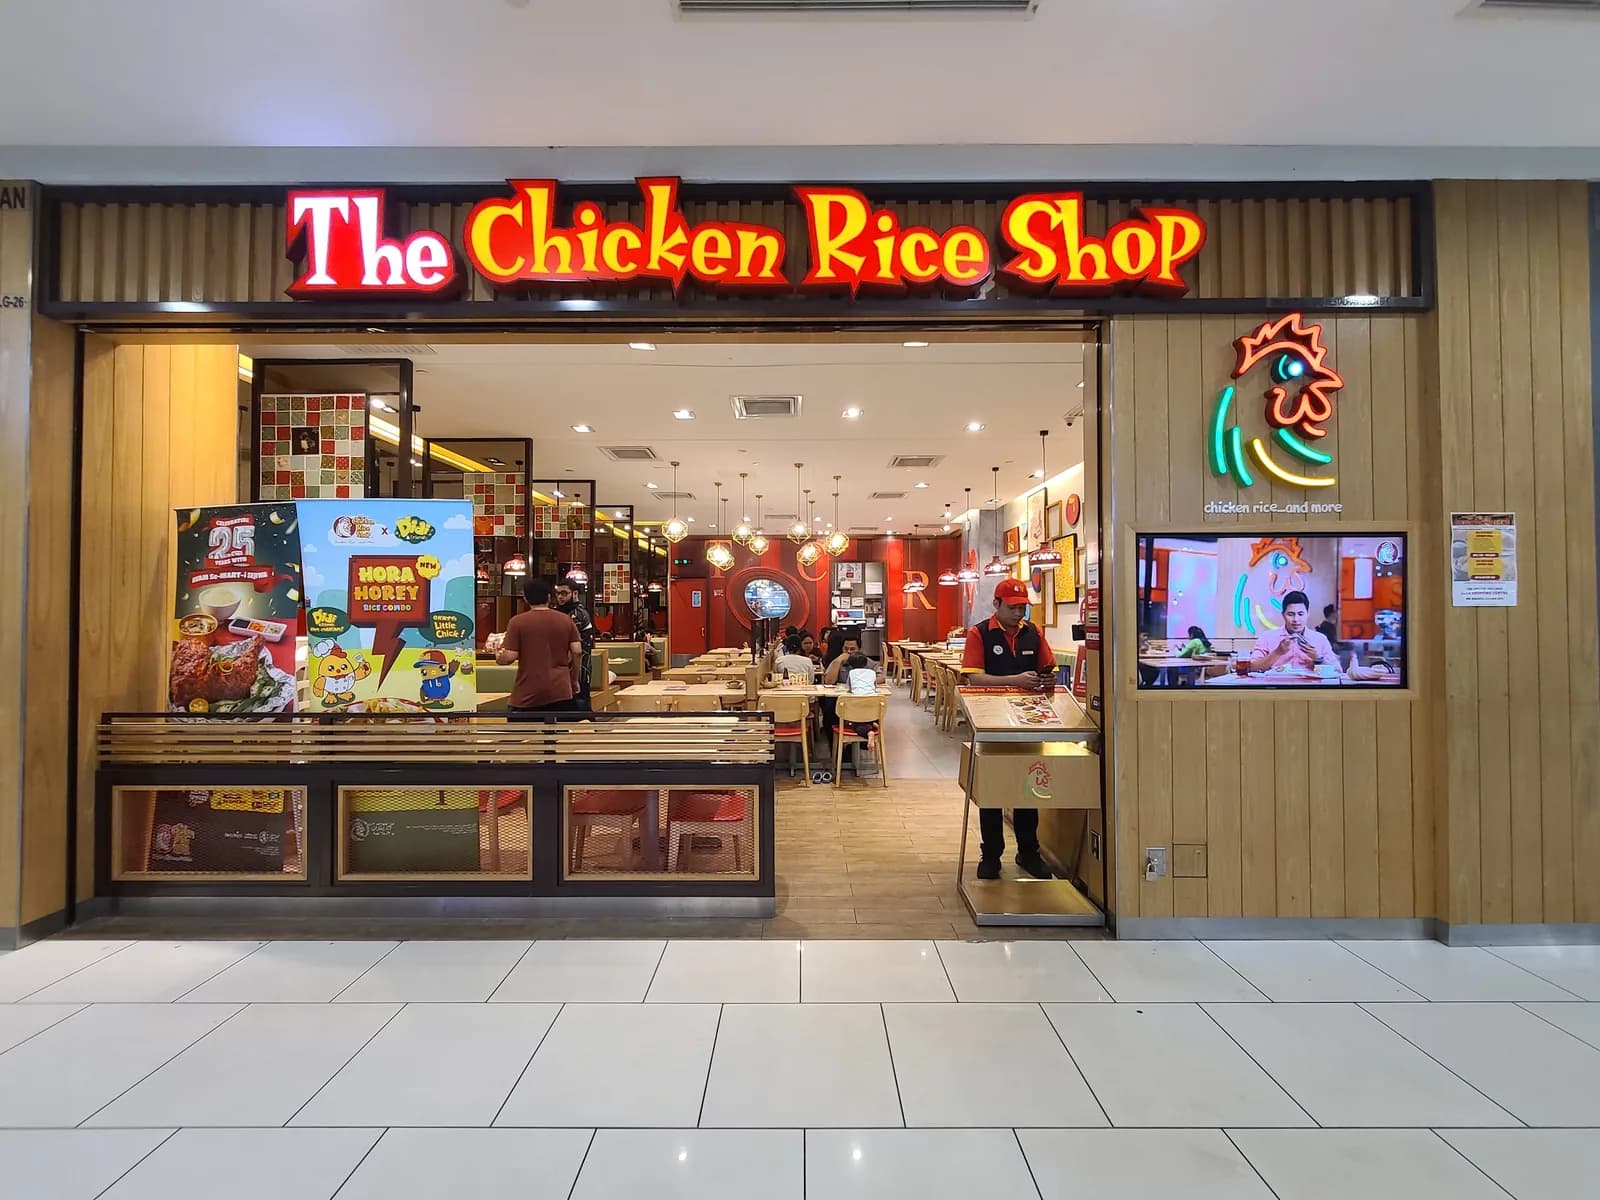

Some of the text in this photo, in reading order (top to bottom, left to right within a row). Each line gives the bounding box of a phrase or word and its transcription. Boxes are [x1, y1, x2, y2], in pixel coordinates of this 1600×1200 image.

[293, 196, 448, 286] The
[471, 185, 779, 281] Chicken
[808, 194, 985, 279] Rice
[0, 295, 24, 308] G-26
[1204, 501, 1249, 513] chicken
[1311, 503, 1343, 513] more
[208, 525, 255, 559] 25
[419, 561, 437, 570] NEW
[358, 565, 416, 583] HORA
[353, 585, 419, 601] HOREY
[362, 603, 412, 612] RICE COMBO
[312, 609, 337, 625] Didi
[434, 621, 457, 630] Little
